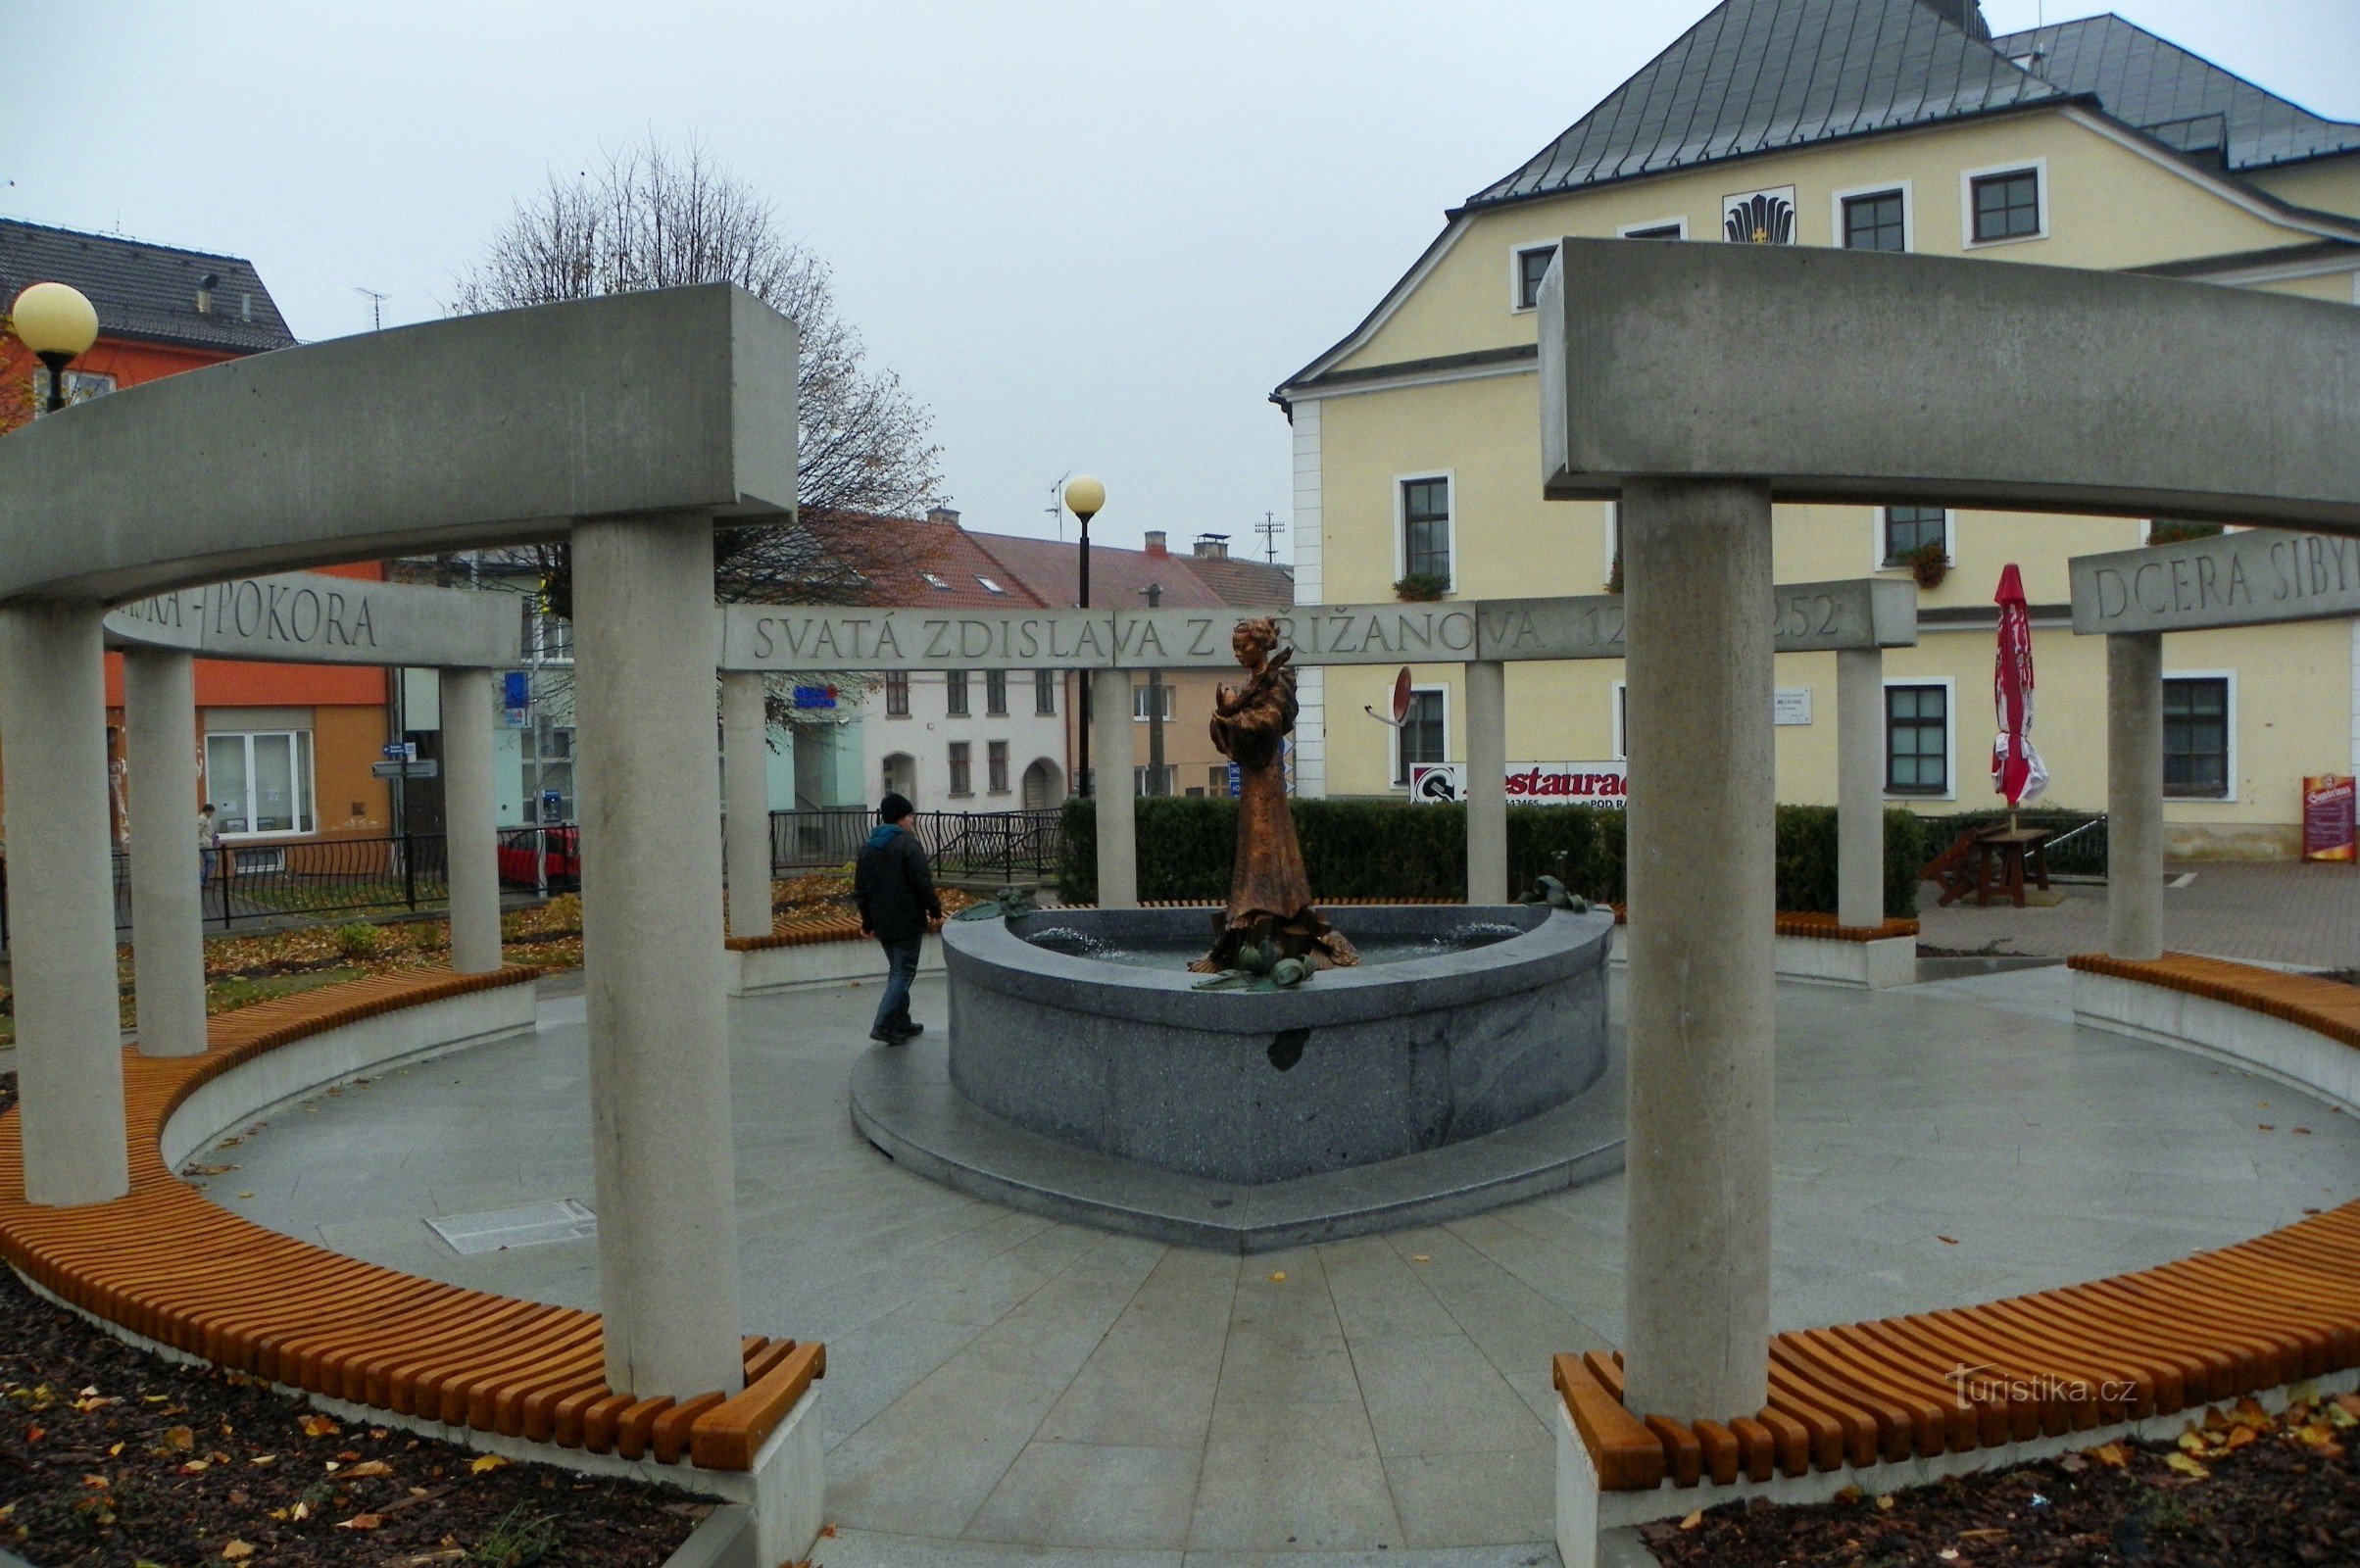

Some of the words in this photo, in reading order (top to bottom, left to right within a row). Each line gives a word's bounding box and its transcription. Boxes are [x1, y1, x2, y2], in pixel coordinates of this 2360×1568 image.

[2093, 551, 2253, 619] DCERA
[2269, 535, 2360, 601] SIBY
[216, 579, 377, 647] POKORA
[755, 611, 906, 660] SVATÁ
[922, 618, 1169, 660] ZDISLAVA
[1186, 617, 1216, 657] Z
[1237, 607, 1547, 655] ŘIŽANOVA
[1585, 605, 1626, 647] 12
[1505, 766, 1628, 796] staura
[1590, 799, 1613, 808] POD
